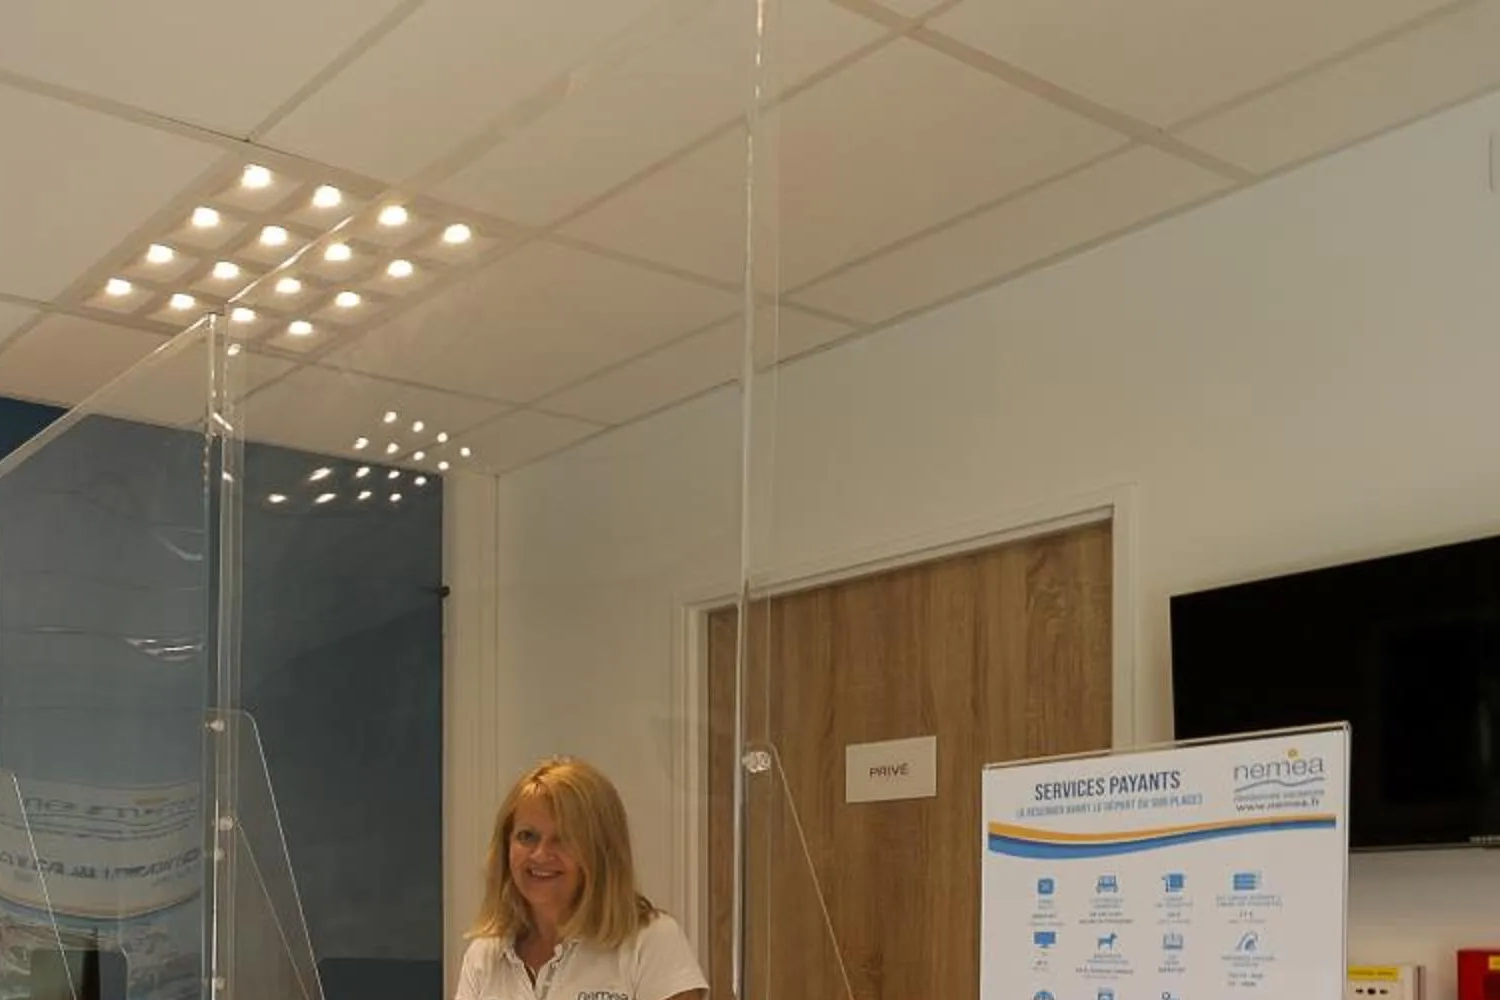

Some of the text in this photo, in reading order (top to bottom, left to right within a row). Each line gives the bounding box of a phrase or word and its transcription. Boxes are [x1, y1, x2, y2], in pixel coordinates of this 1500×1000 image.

[869, 762, 909, 778] PRIVÉ
[1233, 756, 1324, 780] nemea
[1035, 770, 1182, 801] SERVICES PAYANTS
